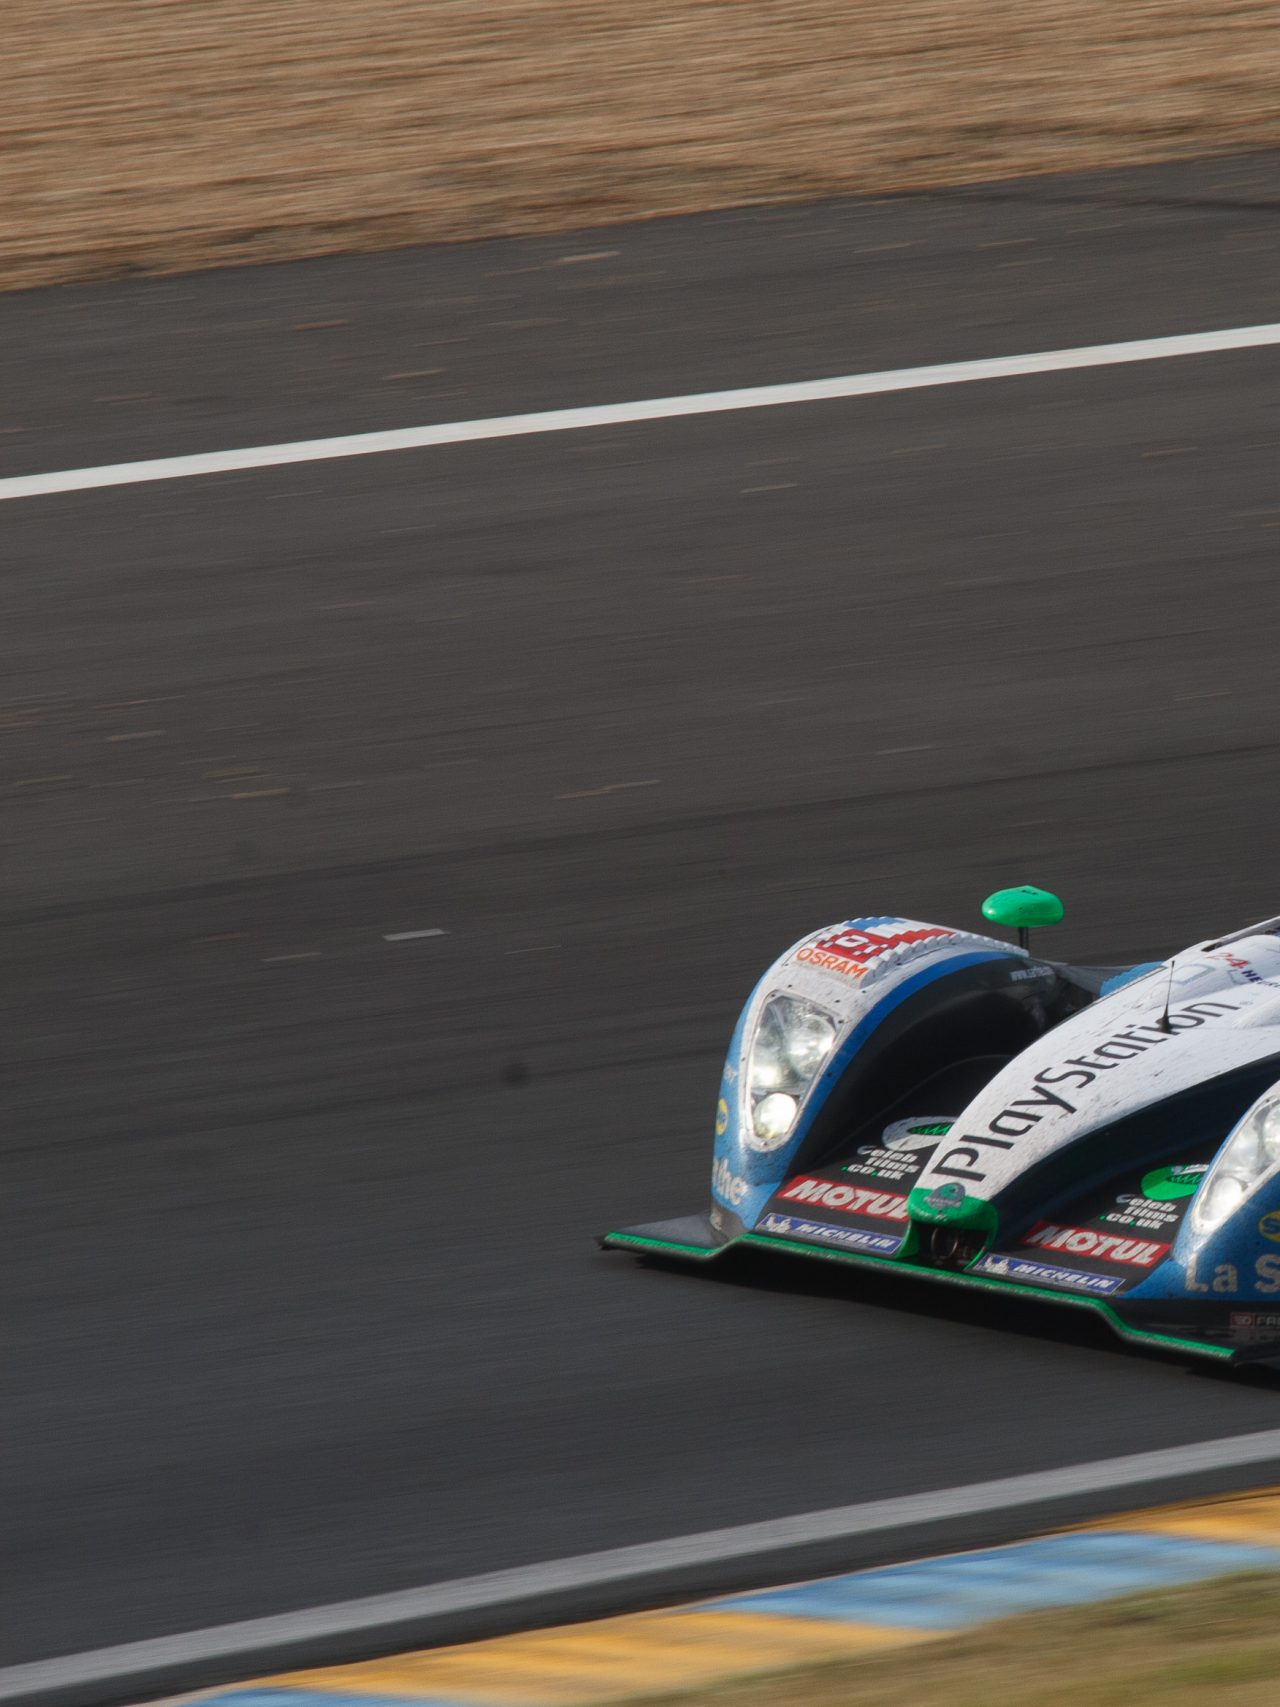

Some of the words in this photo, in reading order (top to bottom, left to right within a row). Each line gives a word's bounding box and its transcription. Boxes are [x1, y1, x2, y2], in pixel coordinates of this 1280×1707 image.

[796, 947, 869, 980] OSRAM
[931, 1001, 1242, 1182] PlayStation
[783, 1179, 910, 1220] MOTUL
[795, 1223, 897, 1250] MICHELIN
[1031, 1226, 1161, 1265] MOTUL
[1013, 1263, 1116, 1289] MICHELIN
[1184, 1252, 1239, 1294] La
